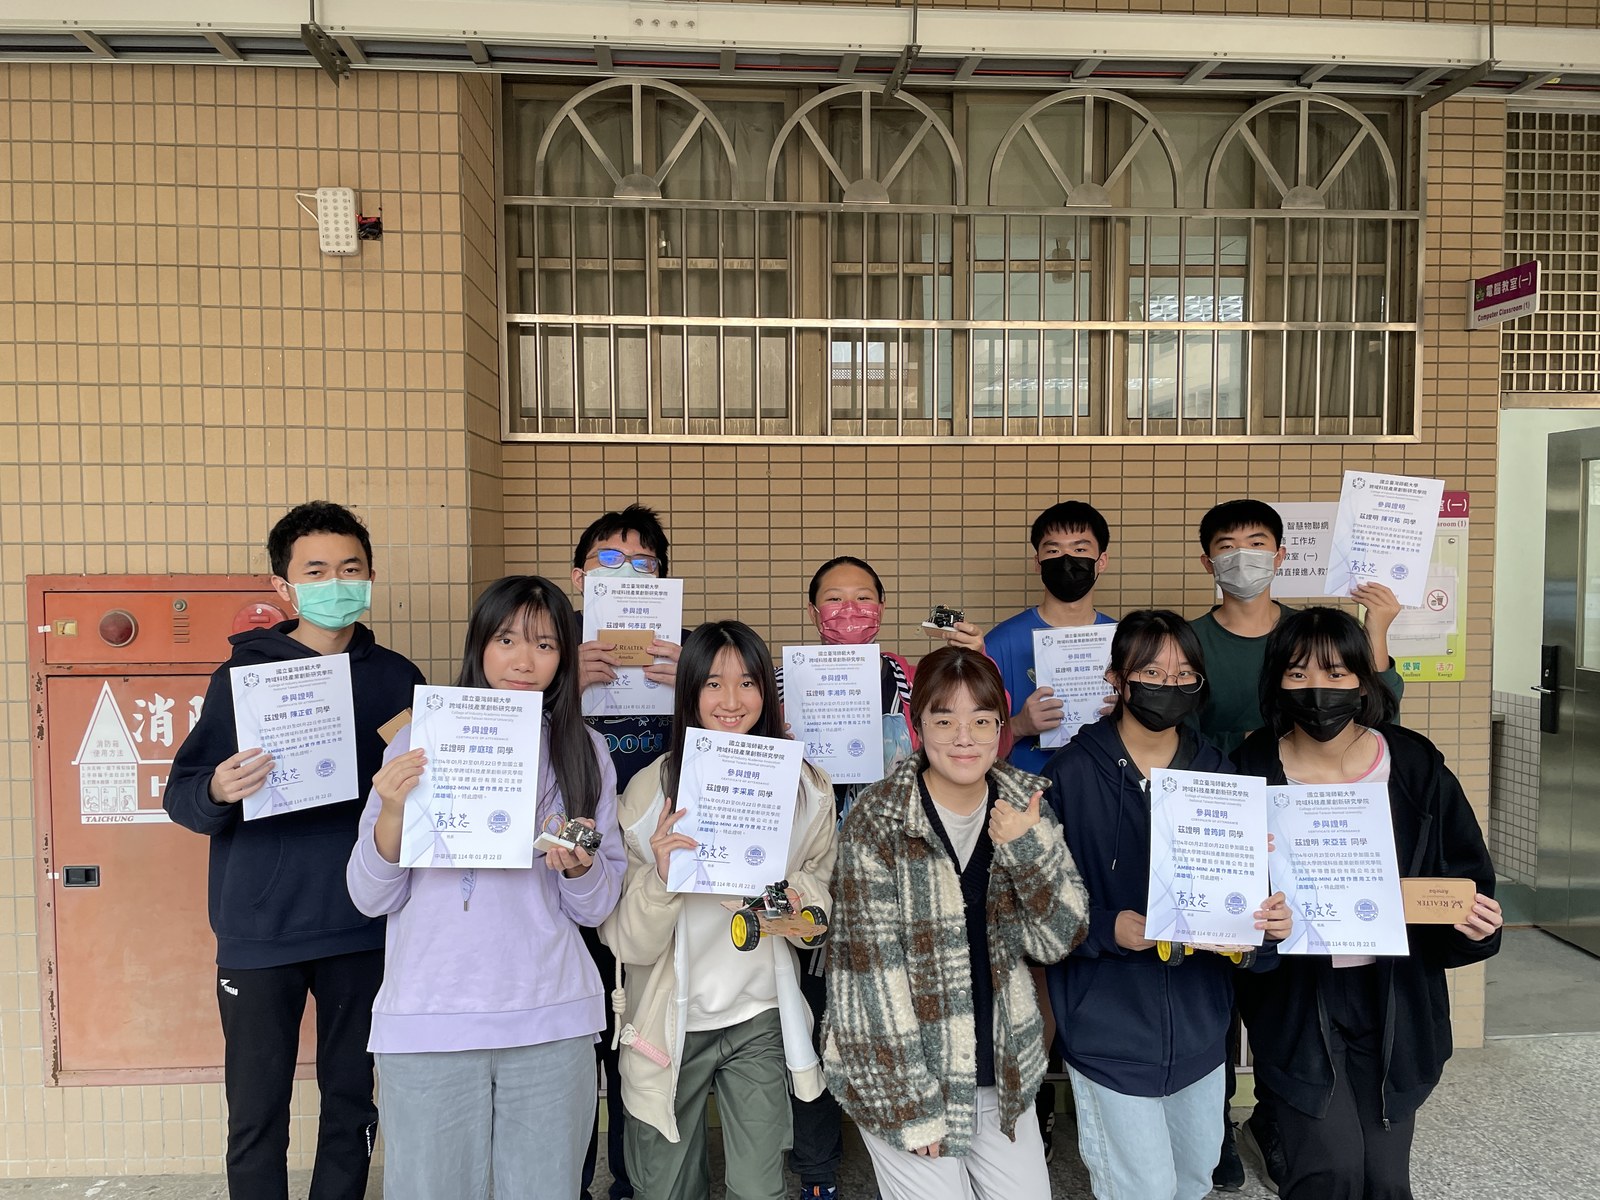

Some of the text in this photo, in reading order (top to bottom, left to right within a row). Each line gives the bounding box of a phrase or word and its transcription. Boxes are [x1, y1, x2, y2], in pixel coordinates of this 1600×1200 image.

[1486, 272, 1531, 297] 電腦教室(一)
[1478, 311, 1498, 321] Computer
[1499, 304, 1522, 316] Classroom
[1377, 501, 1406, 510] 參與證明
[1287, 522, 1329, 530] 智慧物聯網
[1457, 520, 1467, 528] (1)
[1291, 537, 1316, 545] 工作坊
[1303, 552, 1318, 561] (一)
[1402, 662, 1454, 671] 優質 活力
[280, 690, 314, 703] 參與證明
[462, 695, 510, 703] 國立臺灣師範大學
[315, 704, 330, 714] 同學
[448, 702, 522, 712] 跨域科技產業創新研究學院
[462, 725, 498, 735] 參與證明
[496, 746, 513, 754] 同學
[728, 740, 774, 751] 國立臺灣師範大學
[716, 746, 784, 760] 跨域科技產業創新研究學院
[726, 768, 760, 779] 參與證明
[1193, 779, 1237, 788] 國立臺灣師範大學
[757, 789, 773, 798] 同學
[1182, 785, 1249, 797] 跨域科技產業創新研究學院
[1295, 797, 1369, 806] 跨域科技產業創新研究學院
[1195, 808, 1228, 818] 參與證明
[1312, 819, 1348, 828] 參與證明
[1228, 829, 1243, 838] 同學
[1322, 838, 1347, 846] 宋亞芸
[1350, 837, 1368, 845] 同學
